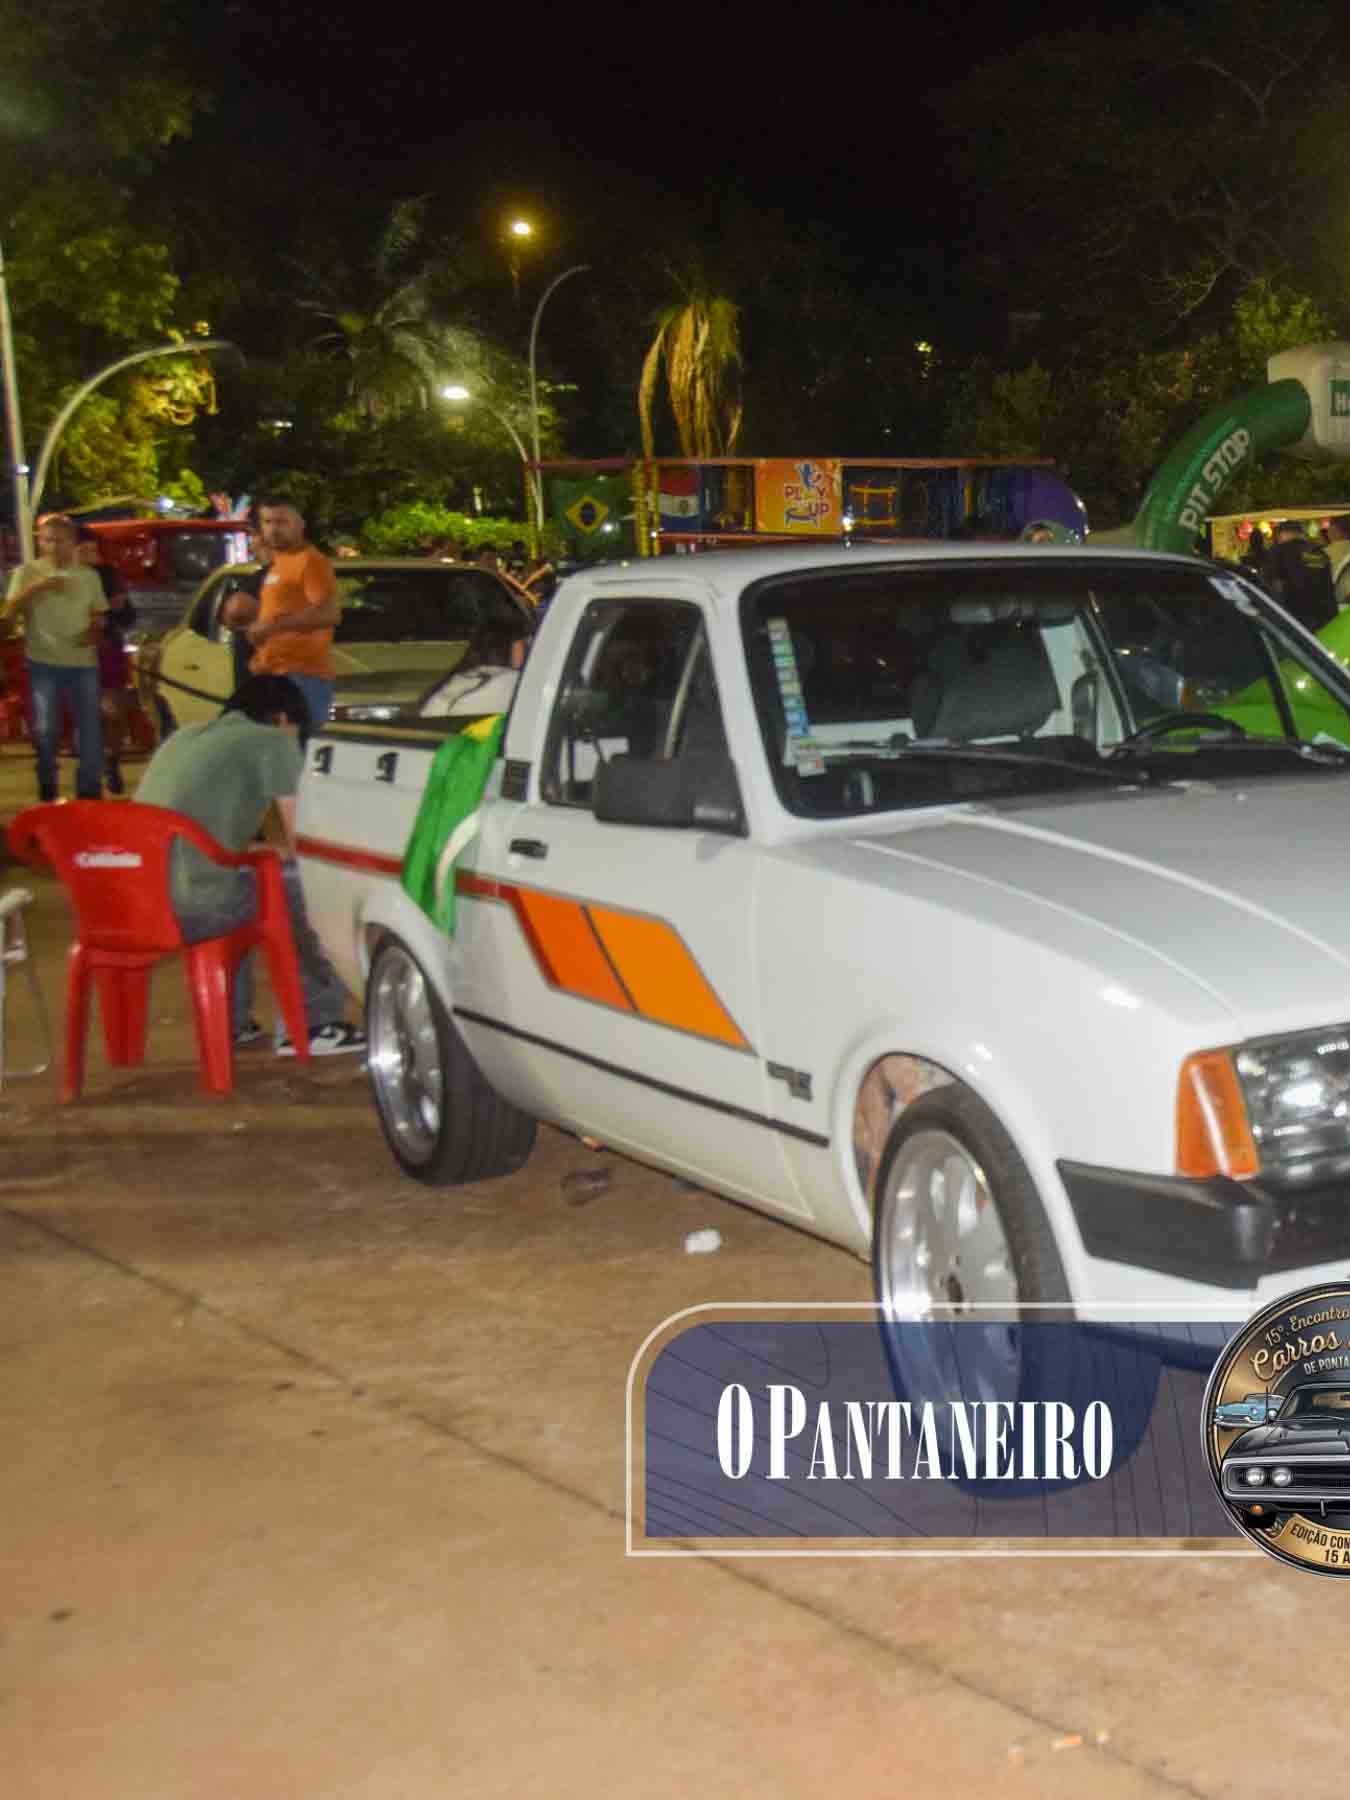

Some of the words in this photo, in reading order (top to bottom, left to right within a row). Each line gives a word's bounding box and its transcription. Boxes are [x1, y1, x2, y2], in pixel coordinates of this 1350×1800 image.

[808, 502, 830, 517] UP
[1178, 482, 1210, 532] PIT
[1202, 428, 1251, 495] STOP
